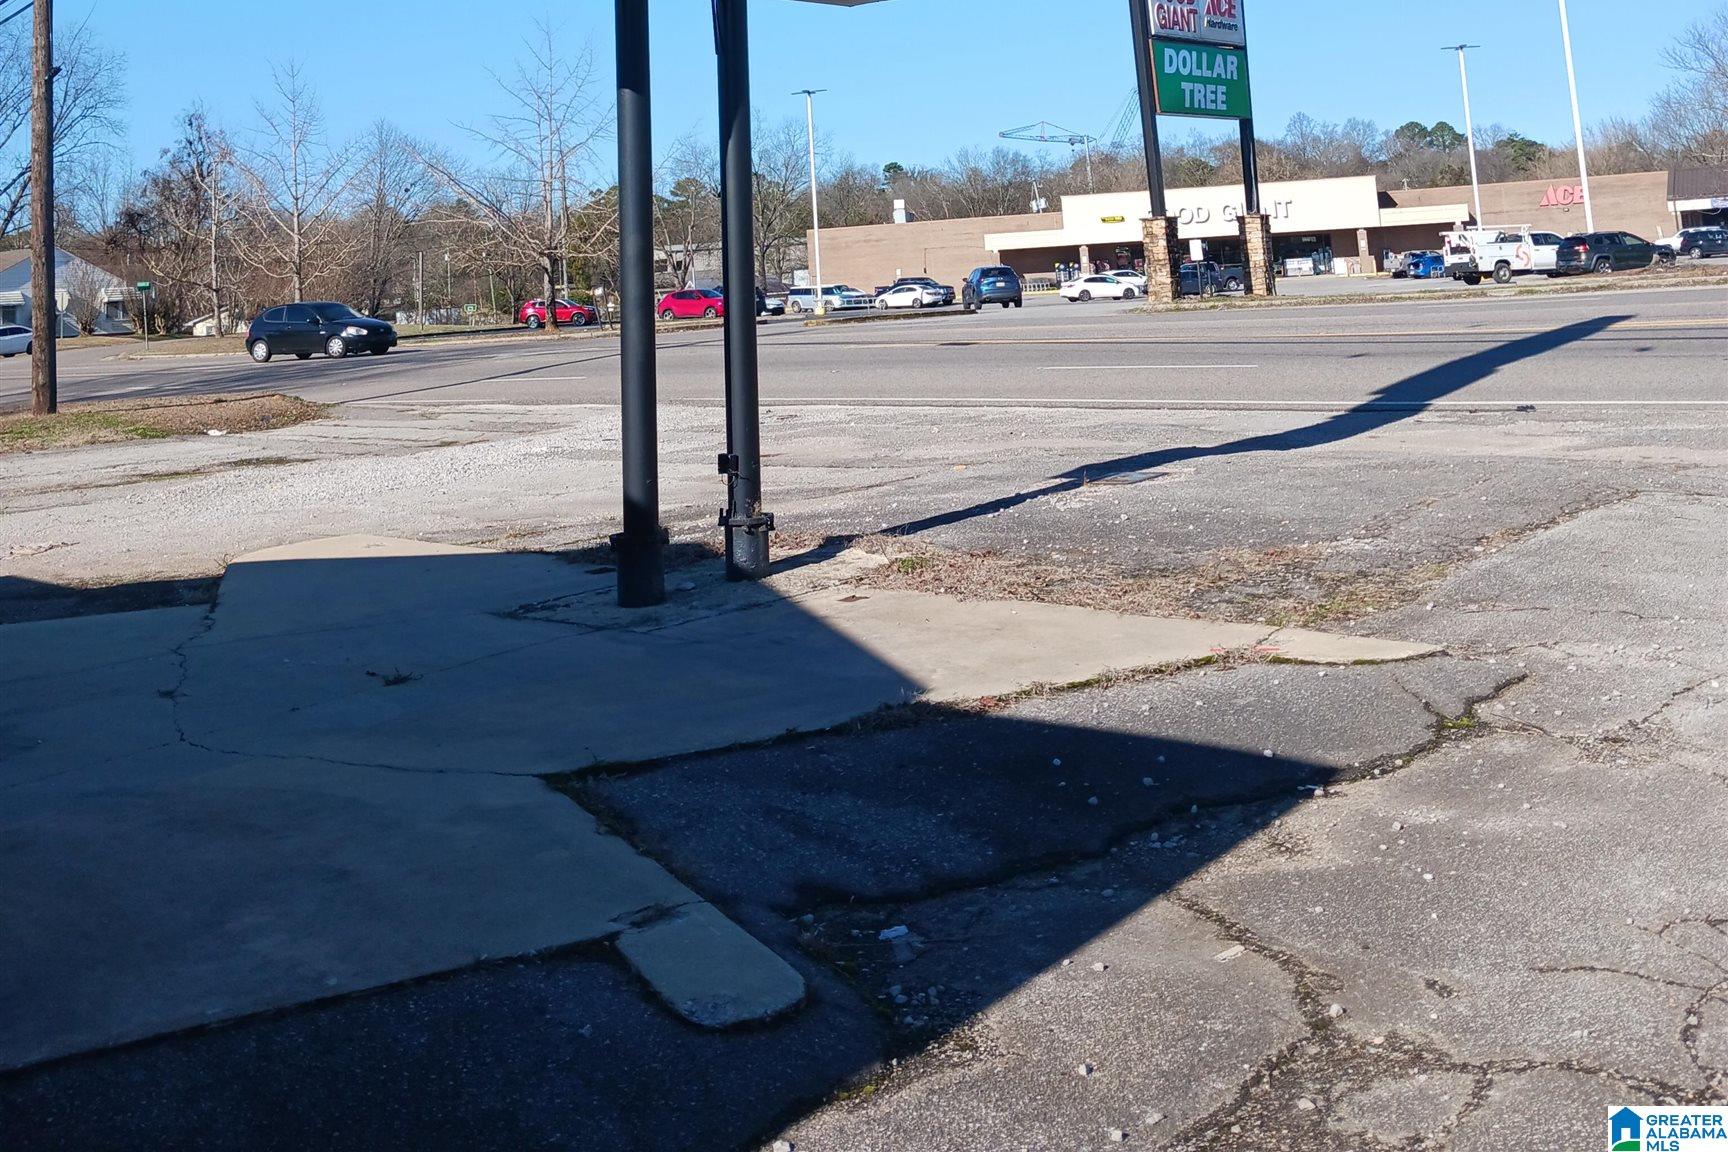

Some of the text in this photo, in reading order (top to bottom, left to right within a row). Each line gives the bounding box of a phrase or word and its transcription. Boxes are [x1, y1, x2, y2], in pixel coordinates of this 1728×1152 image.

[1155, 2, 1198, 33] GIANT
[1205, 17, 1239, 31] Hardware
[1164, 47, 1238, 80] DOLLAR
[1181, 81, 1227, 110] TREE
[1540, 184, 1584, 207] ACE
